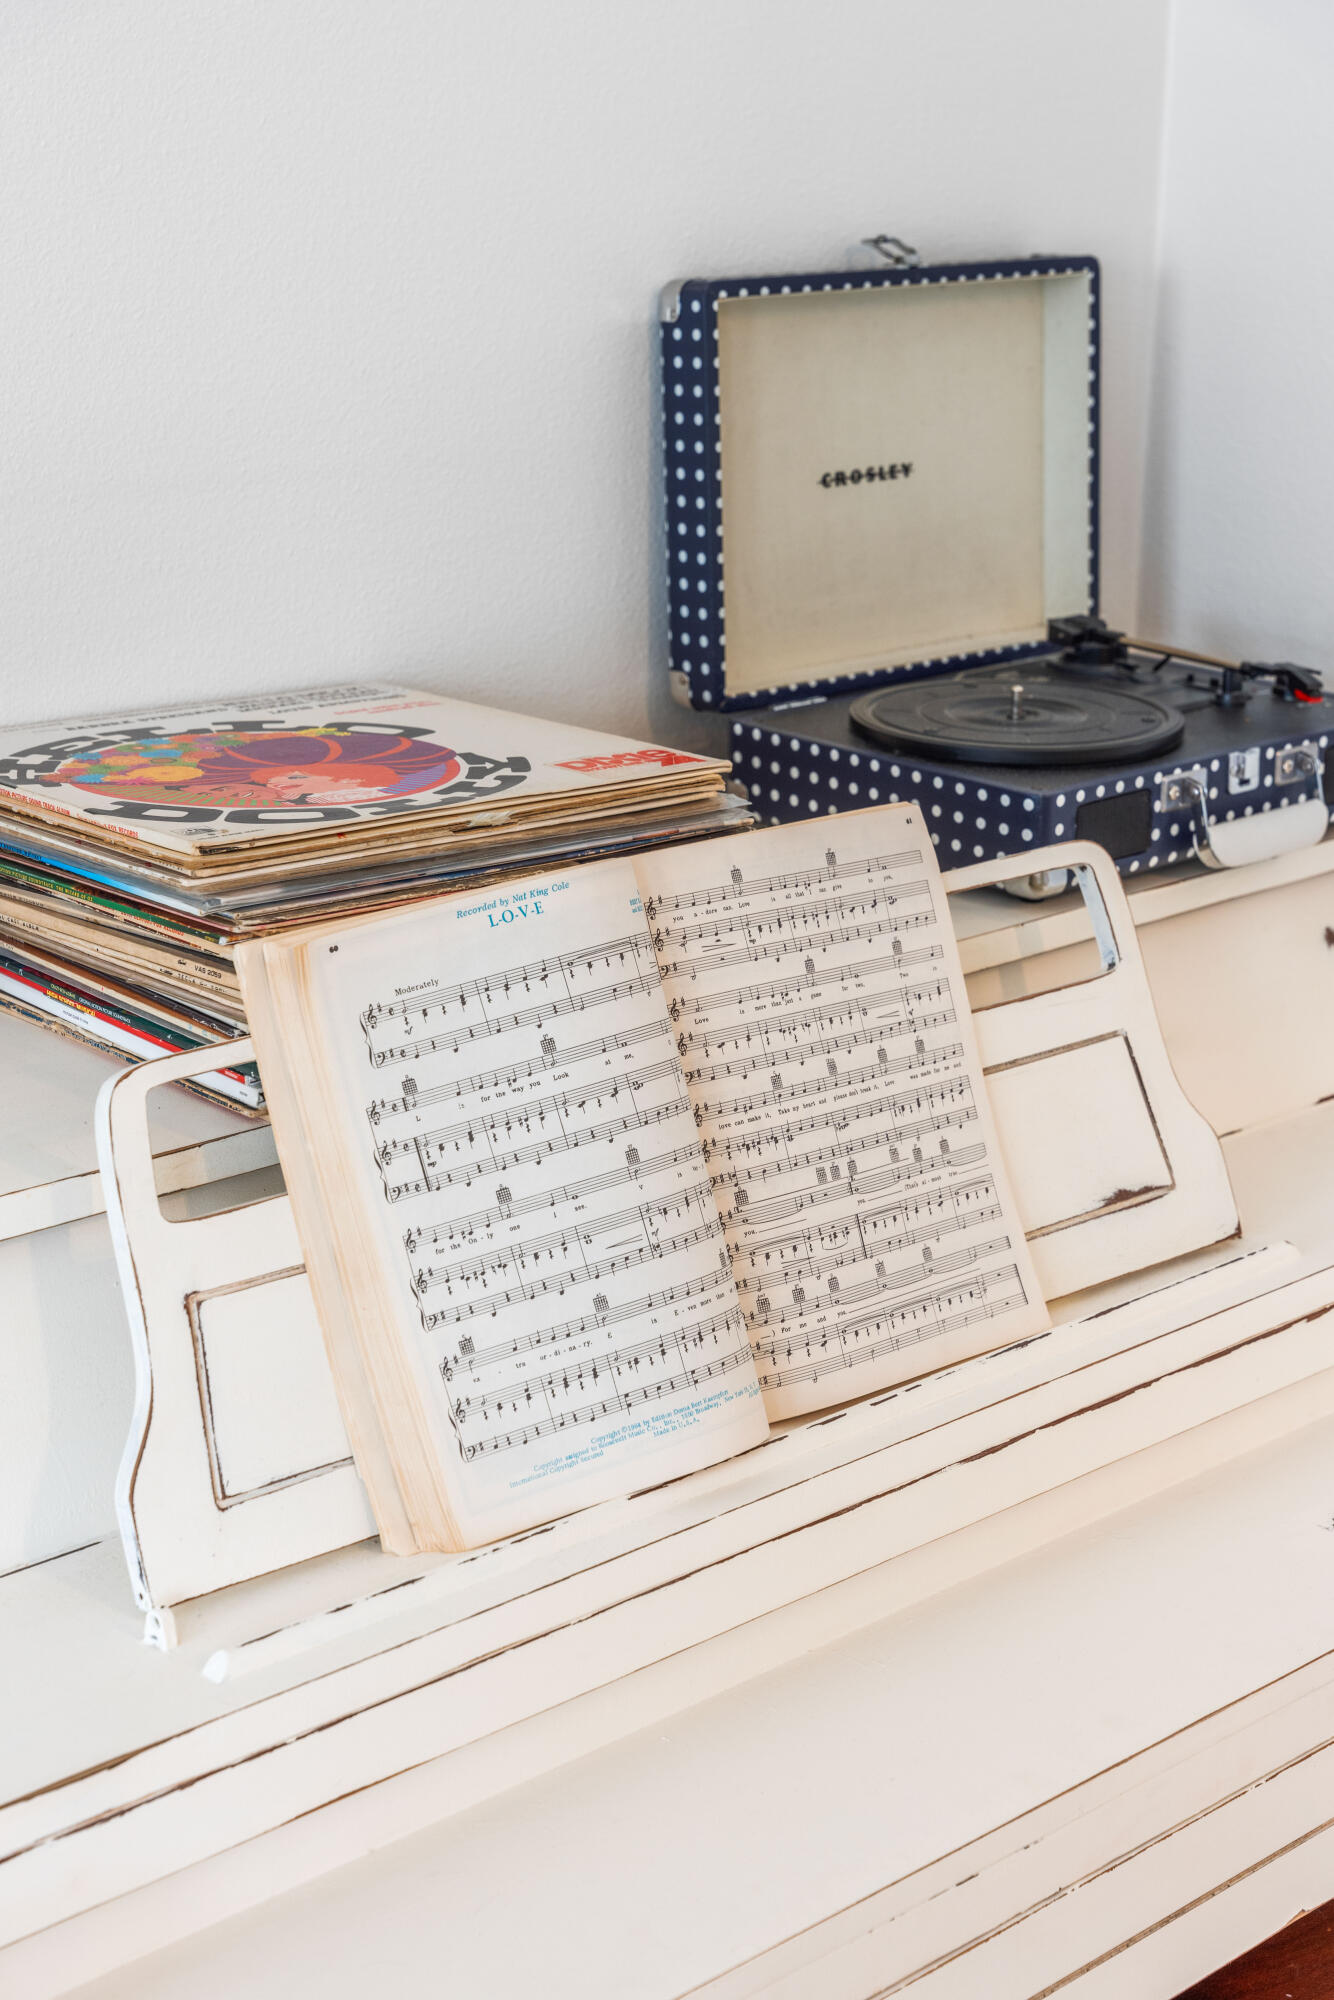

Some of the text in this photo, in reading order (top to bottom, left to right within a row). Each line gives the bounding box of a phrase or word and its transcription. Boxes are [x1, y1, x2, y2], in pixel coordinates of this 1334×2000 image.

[818, 461, 913, 488] CROSLEY
[456, 881, 570, 919] Recorded by Nat King Cole
[488, 900, 544, 928] L-O-V-E
[329, 945, 338, 954] 60
[194, 964, 206, 974] VAS
[394, 978, 440, 996] Moderately
[553, 1072, 570, 1081] Look
[480, 1096, 490, 1104] for
[496, 1090, 506, 1098] the
[529, 1080, 541, 1090] you
[718, 1122, 732, 1130] love
[748, 1115, 762, 1123] make
[778, 1108, 790, 1116] Take
[450, 1242, 460, 1250] the
[590, 1429, 620, 1444] Copyright
[643, 1419, 650, 1427] by
[653, 1427, 670, 1438] Made
[533, 1457, 563, 1472] Copyright
[550, 1459, 579, 1475] Copyright
